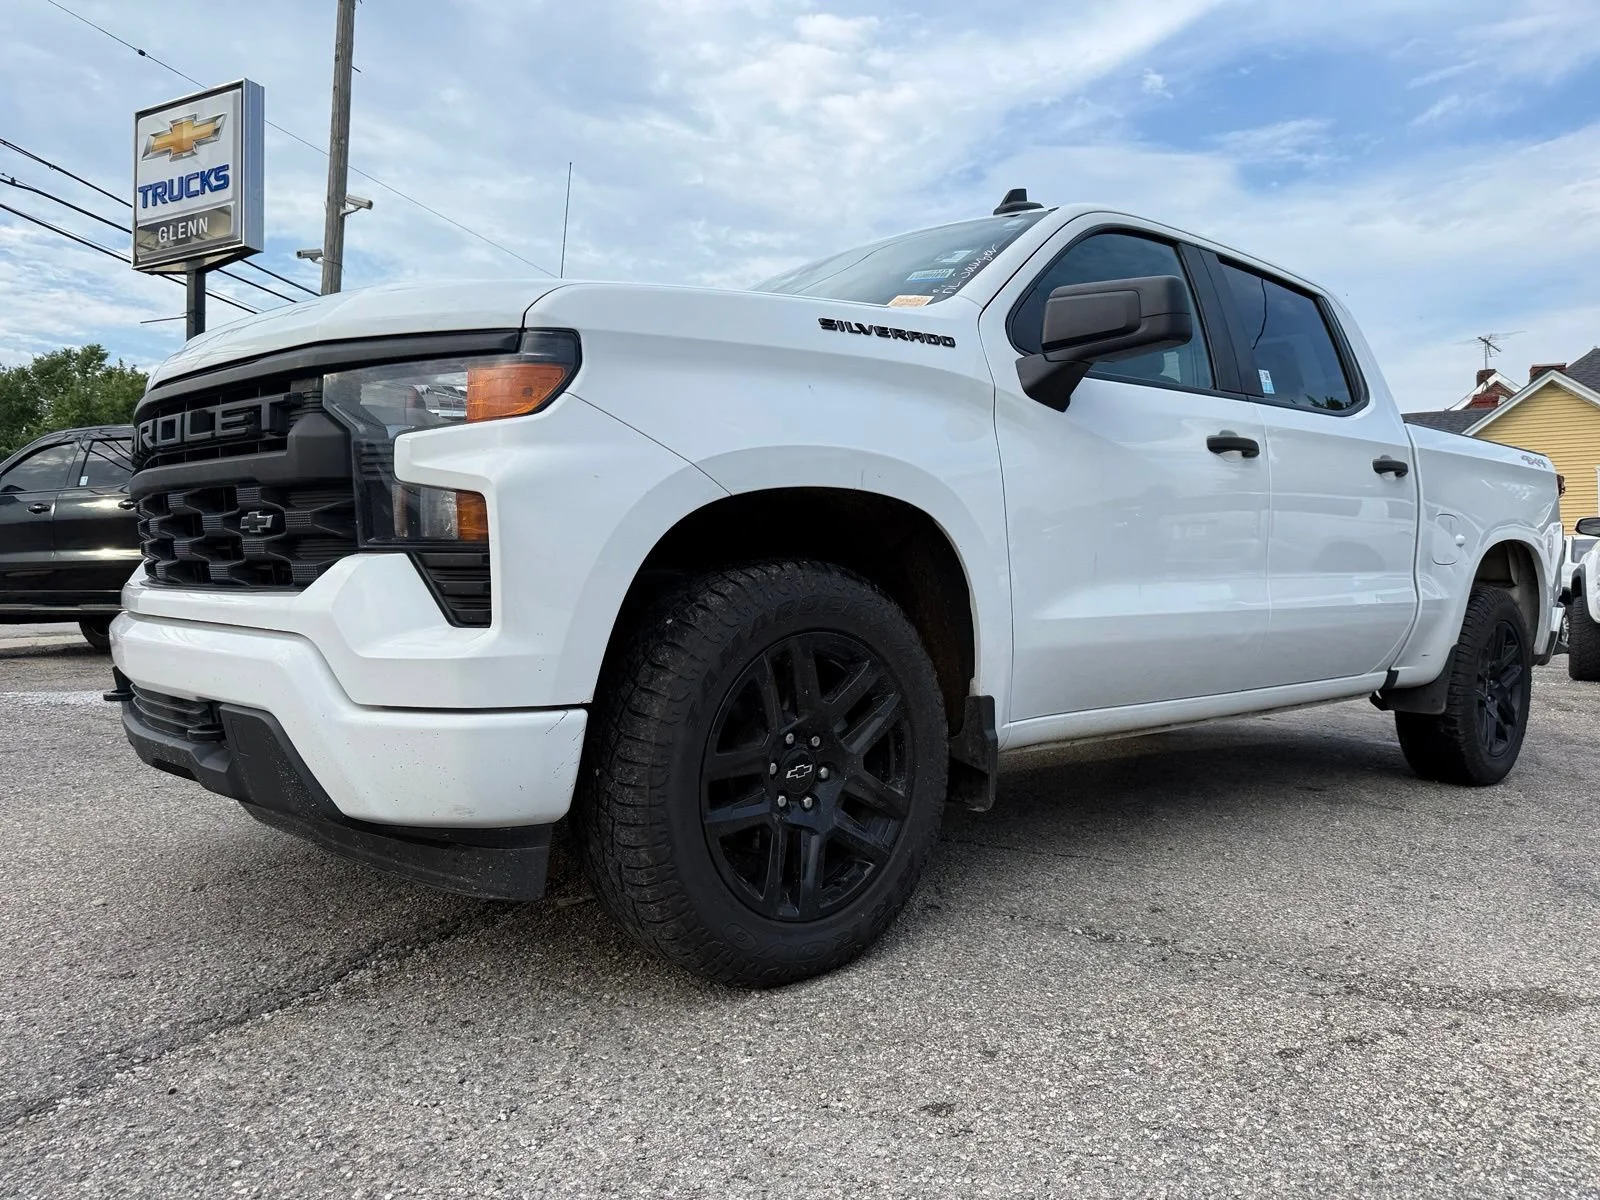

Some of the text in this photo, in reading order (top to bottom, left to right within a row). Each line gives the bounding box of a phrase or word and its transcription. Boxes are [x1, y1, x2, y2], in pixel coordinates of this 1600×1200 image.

[138, 164, 230, 209] TRUCKS
[158, 217, 208, 243] GLENN
[818, 317, 956, 348] SILVERADO
[135, 391, 290, 454] ROLET
